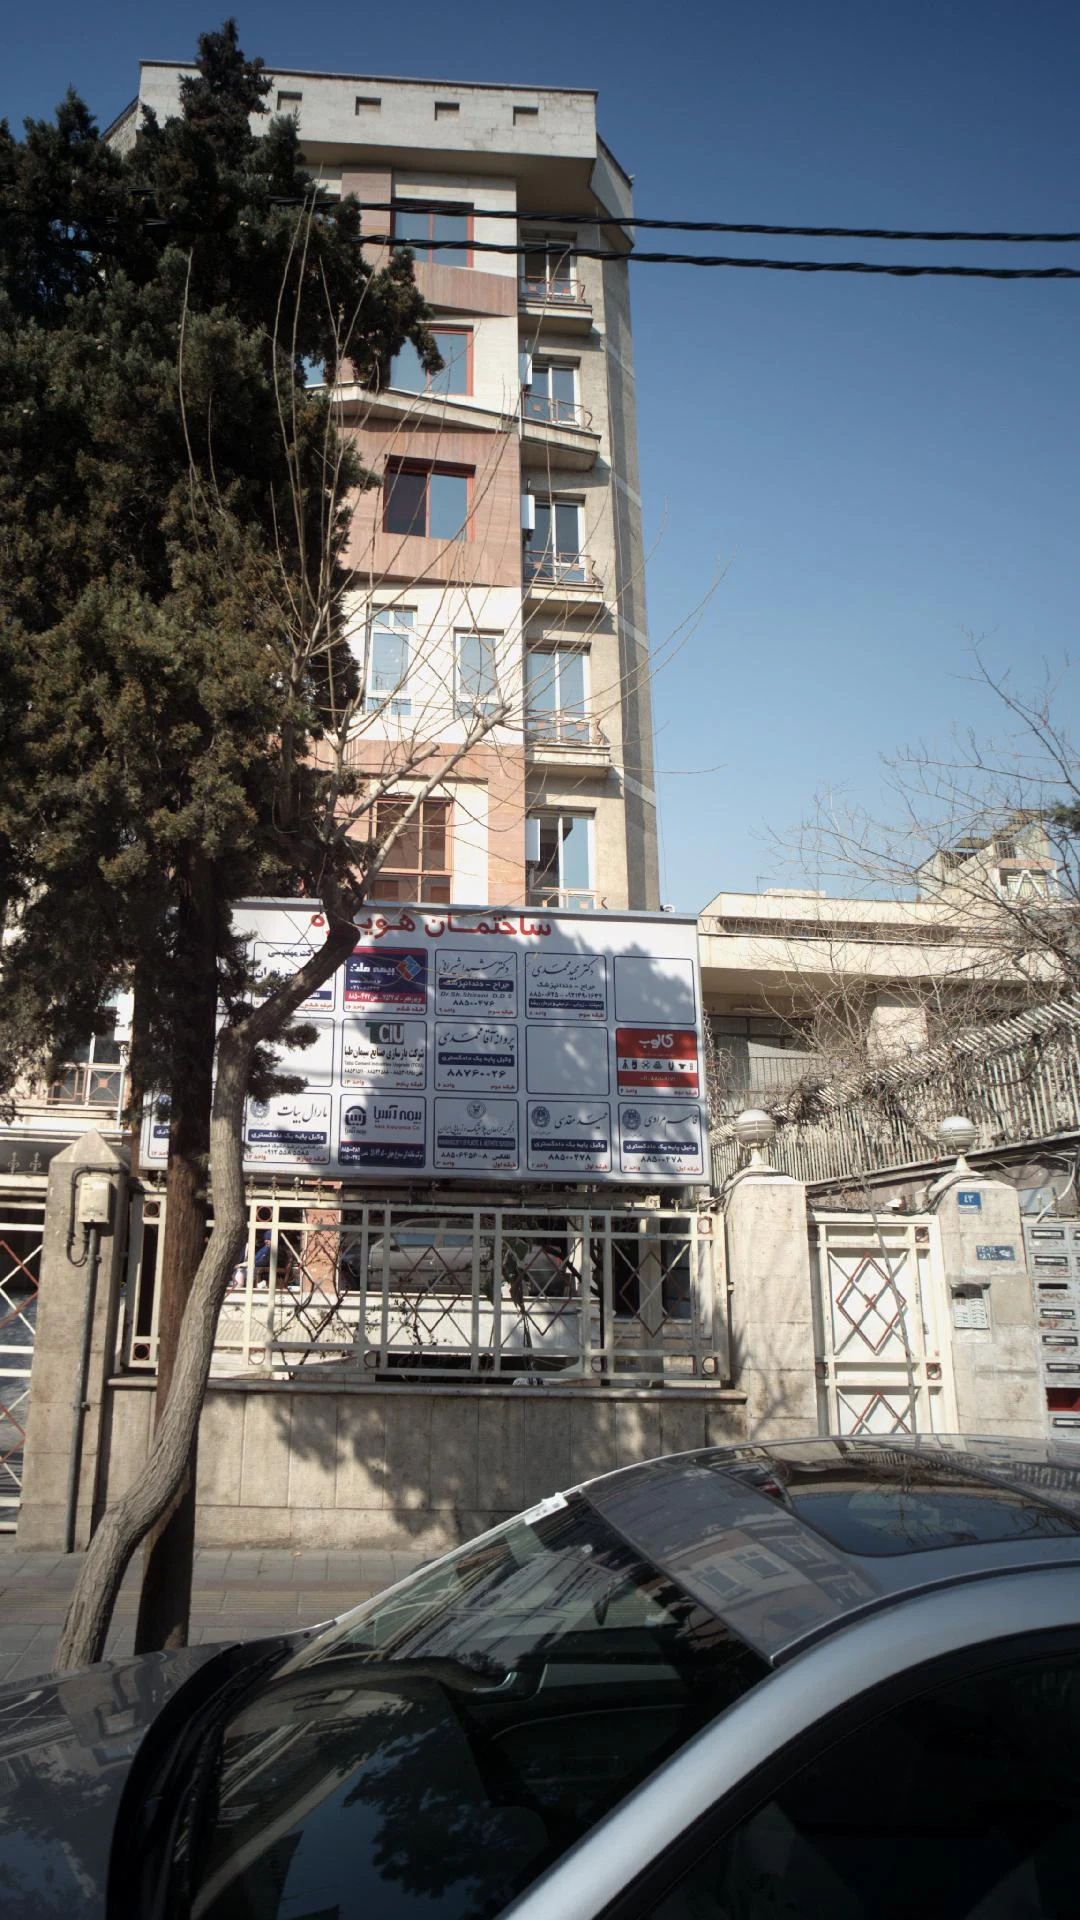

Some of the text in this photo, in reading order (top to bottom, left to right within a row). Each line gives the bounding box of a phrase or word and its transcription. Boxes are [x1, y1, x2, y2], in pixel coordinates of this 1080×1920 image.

[425, 913, 552, 938] ساختمان
[350, 962, 396, 975] بیمه ملت
[536, 981, 573, 990] دندانپزشک
[352, 1046, 369, 1059] سیمان
[370, 1047, 386, 1059] صنایع
[408, 1048, 424, 1061] شرکت
[277, 1105, 301, 1124] بیات
[373, 1104, 422, 1125] بیمه آسیا
[576, 1141, 589, 1149] پایه
[667, 1144, 680, 1152] پایه
[680, 1144, 697, 1152] وکیل
